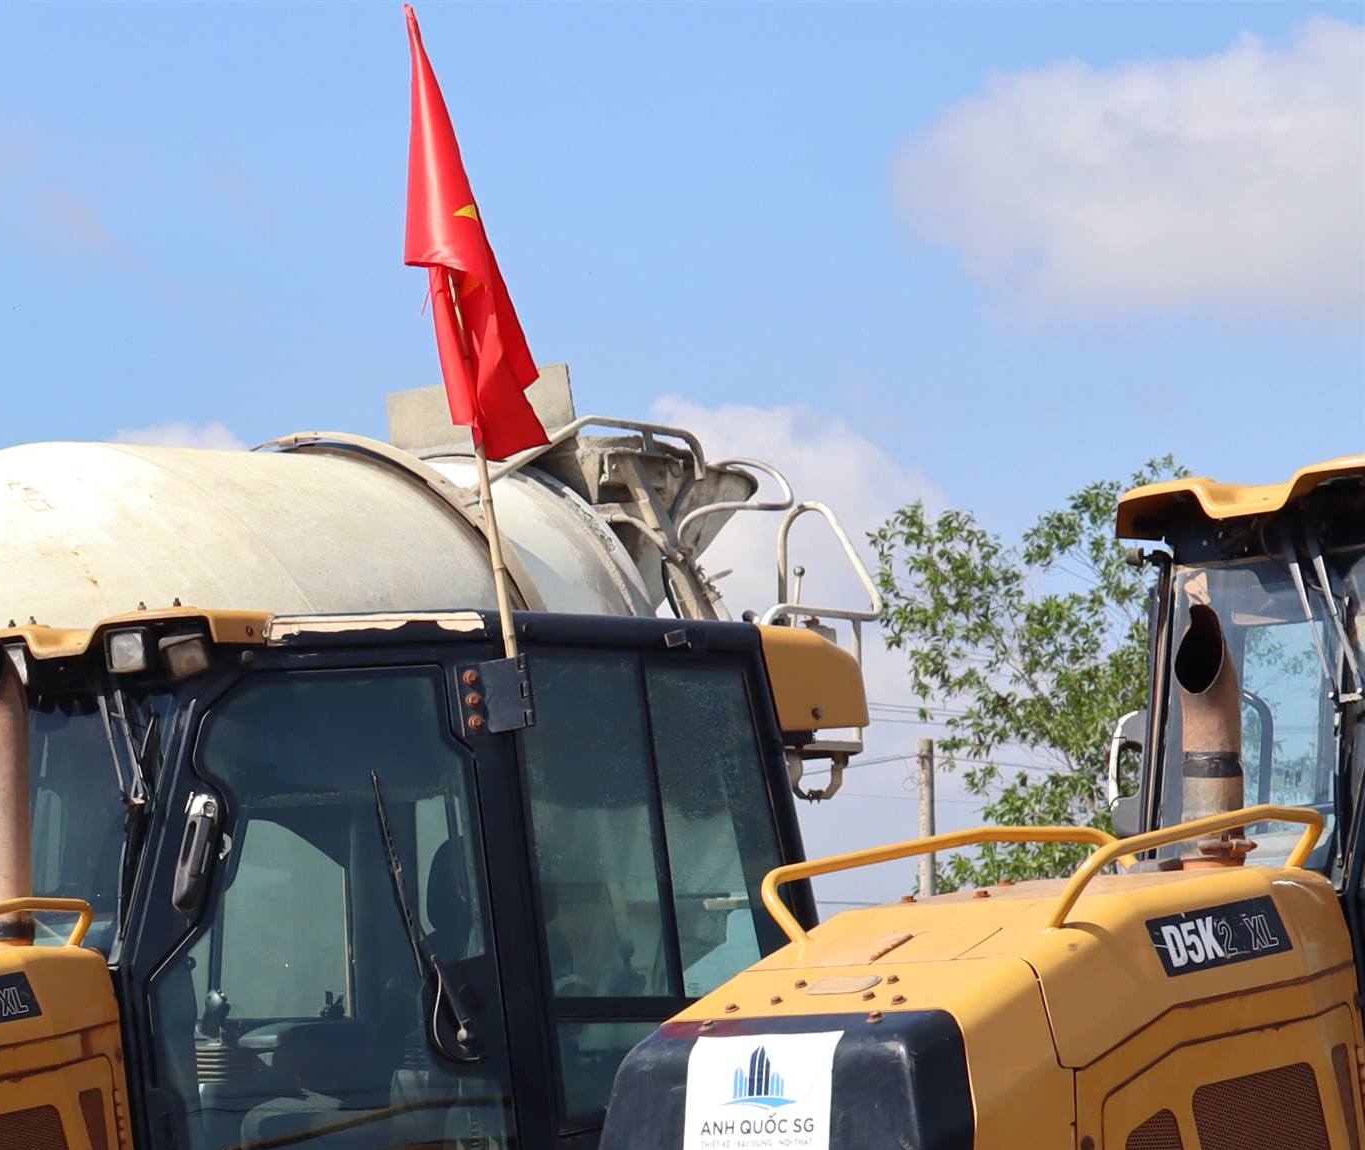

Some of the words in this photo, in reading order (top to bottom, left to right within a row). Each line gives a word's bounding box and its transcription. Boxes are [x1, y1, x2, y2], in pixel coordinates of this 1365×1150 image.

[1161, 916, 1237, 968] D5K2
[1244, 914, 1279, 950] XL
[701, 1120, 735, 1136] ANH
[740, 1112, 789, 1135] QUỐC
[793, 1118, 815, 1133] SG
